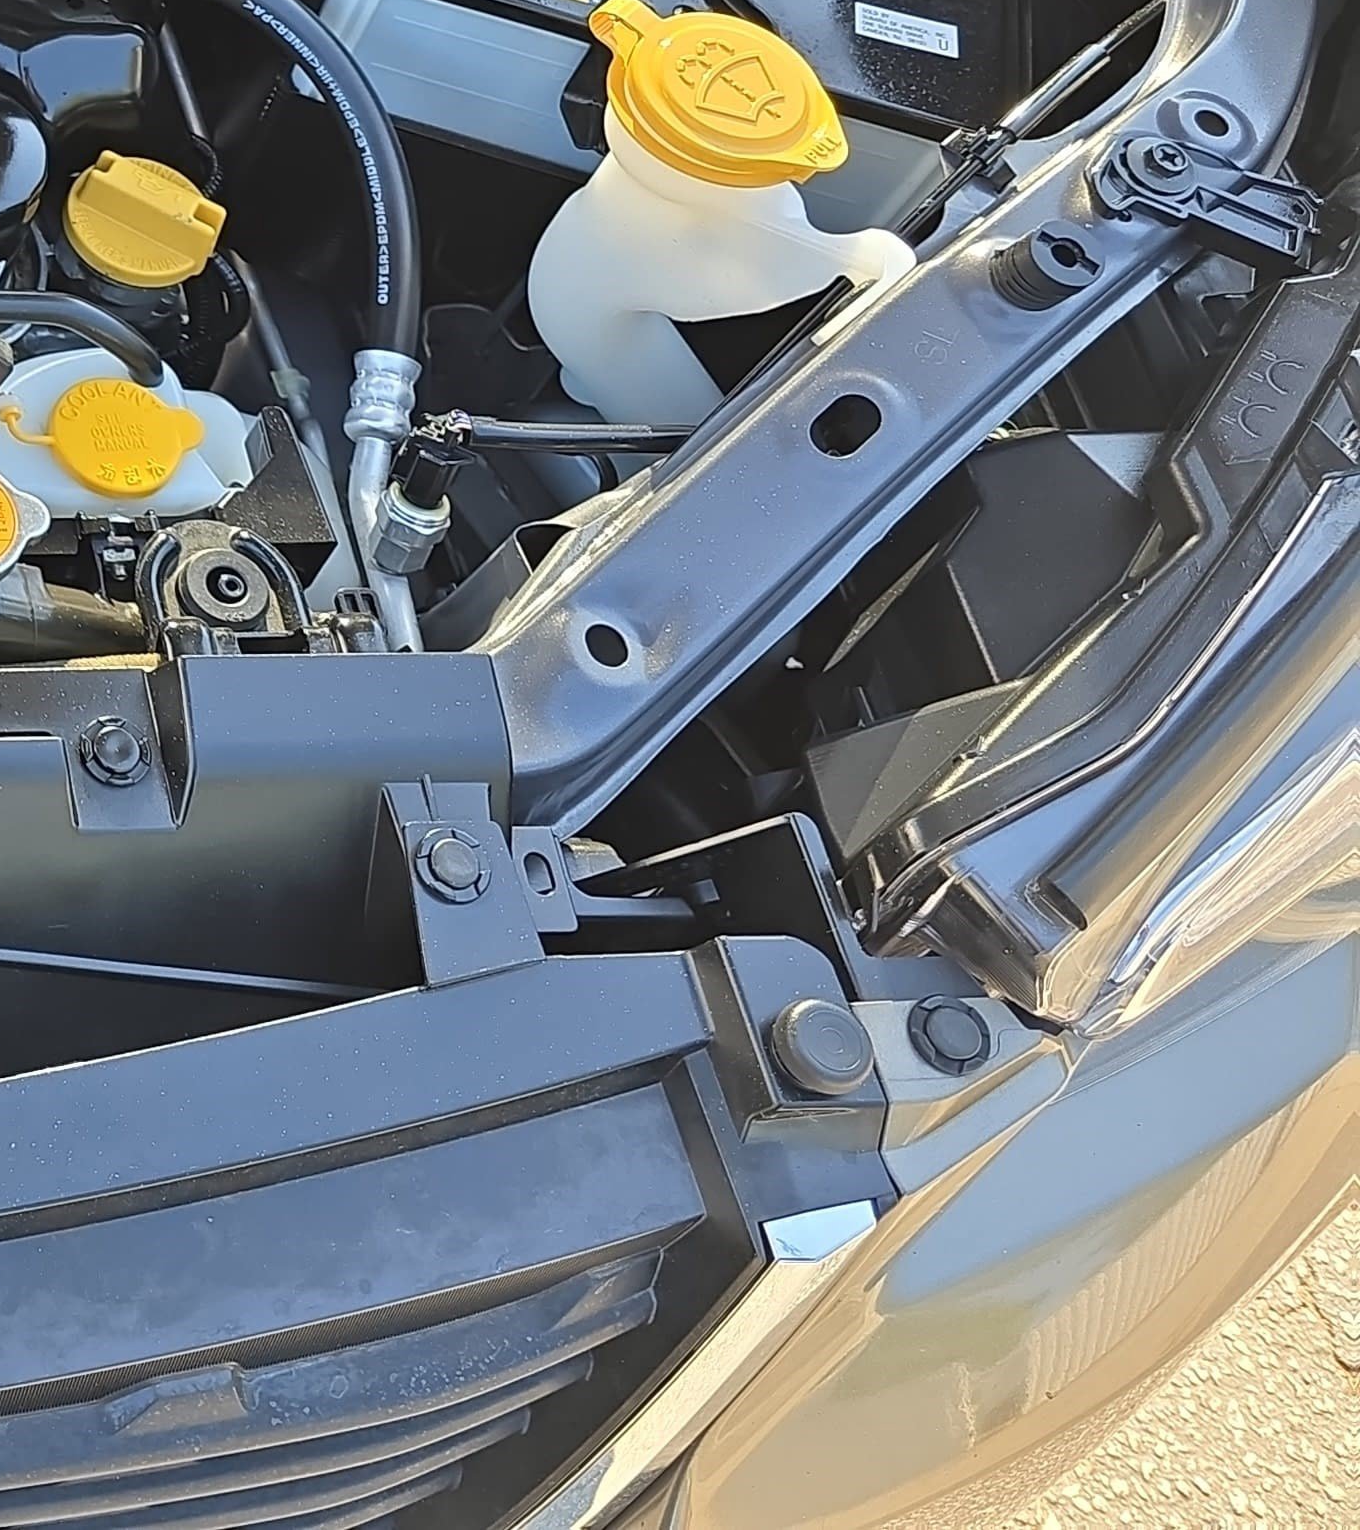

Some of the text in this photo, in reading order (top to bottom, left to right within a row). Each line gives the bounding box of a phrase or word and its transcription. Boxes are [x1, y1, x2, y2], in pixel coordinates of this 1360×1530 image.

[938, 39, 949, 51] U
[804, 136, 842, 164] PULL
[94, 438, 150, 452] MANUAL
